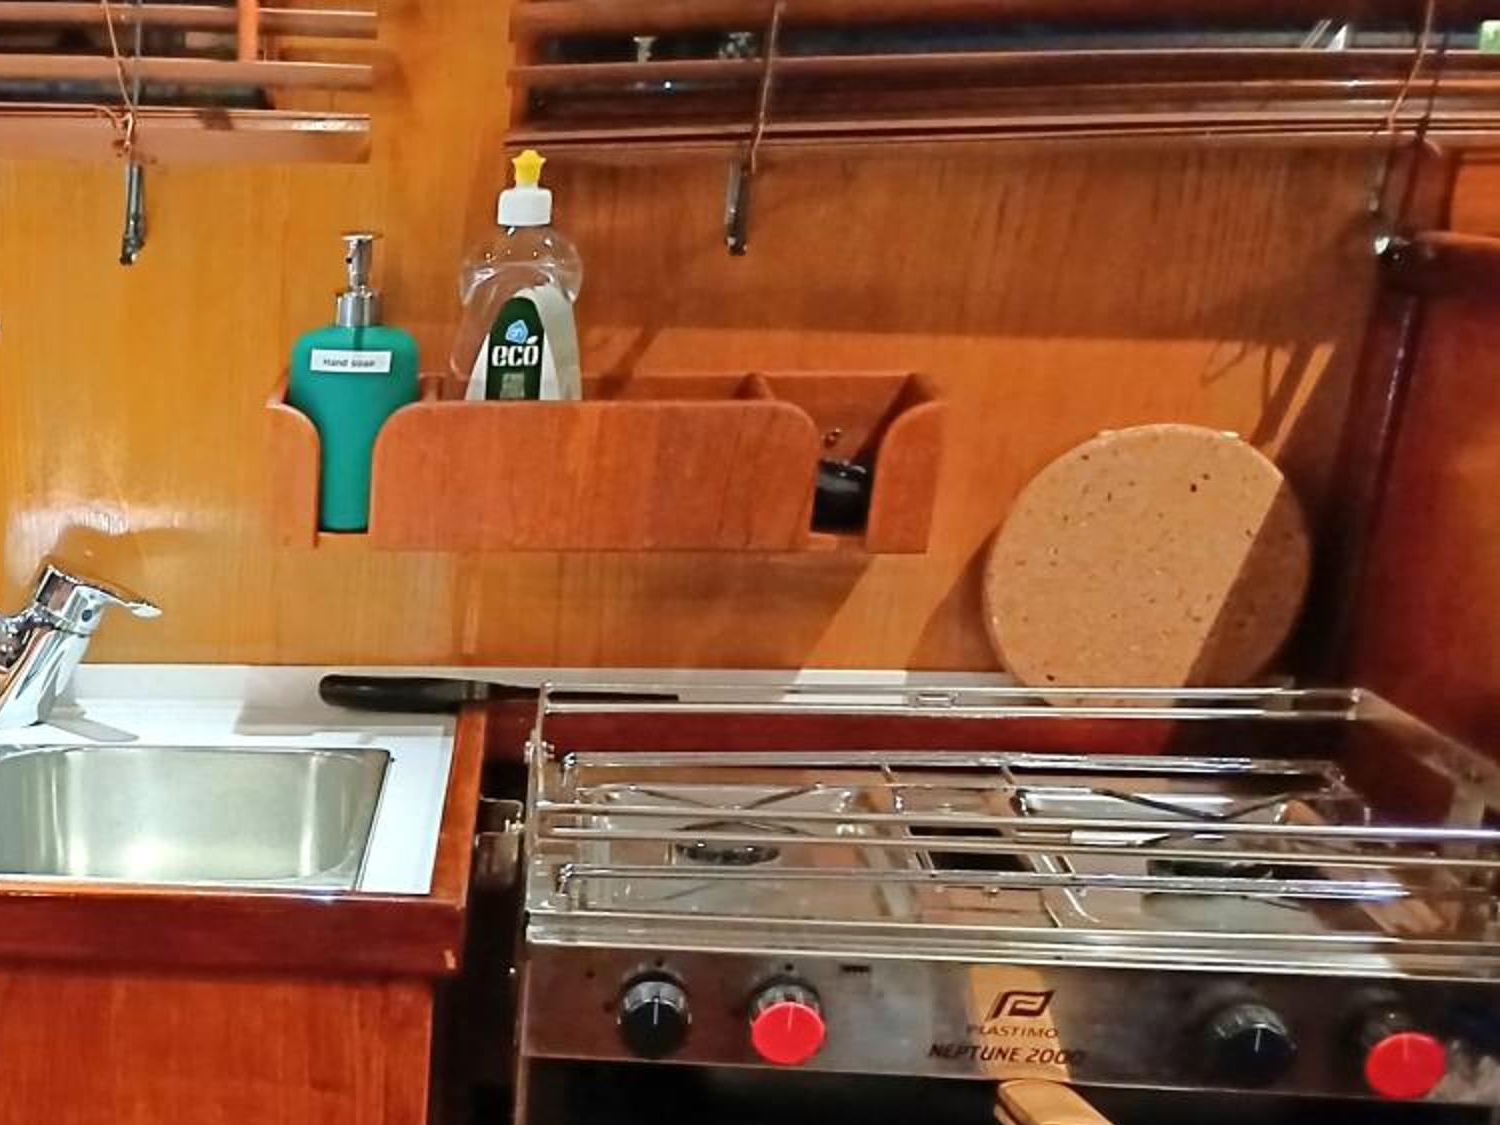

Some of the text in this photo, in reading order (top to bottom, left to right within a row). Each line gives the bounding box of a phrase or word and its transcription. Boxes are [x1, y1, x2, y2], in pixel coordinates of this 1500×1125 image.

[323, 358, 348, 367] Hand
[966, 1023, 1060, 1039] PLASTIMO
[928, 1043, 1086, 1065] NEPTUNE 2000
